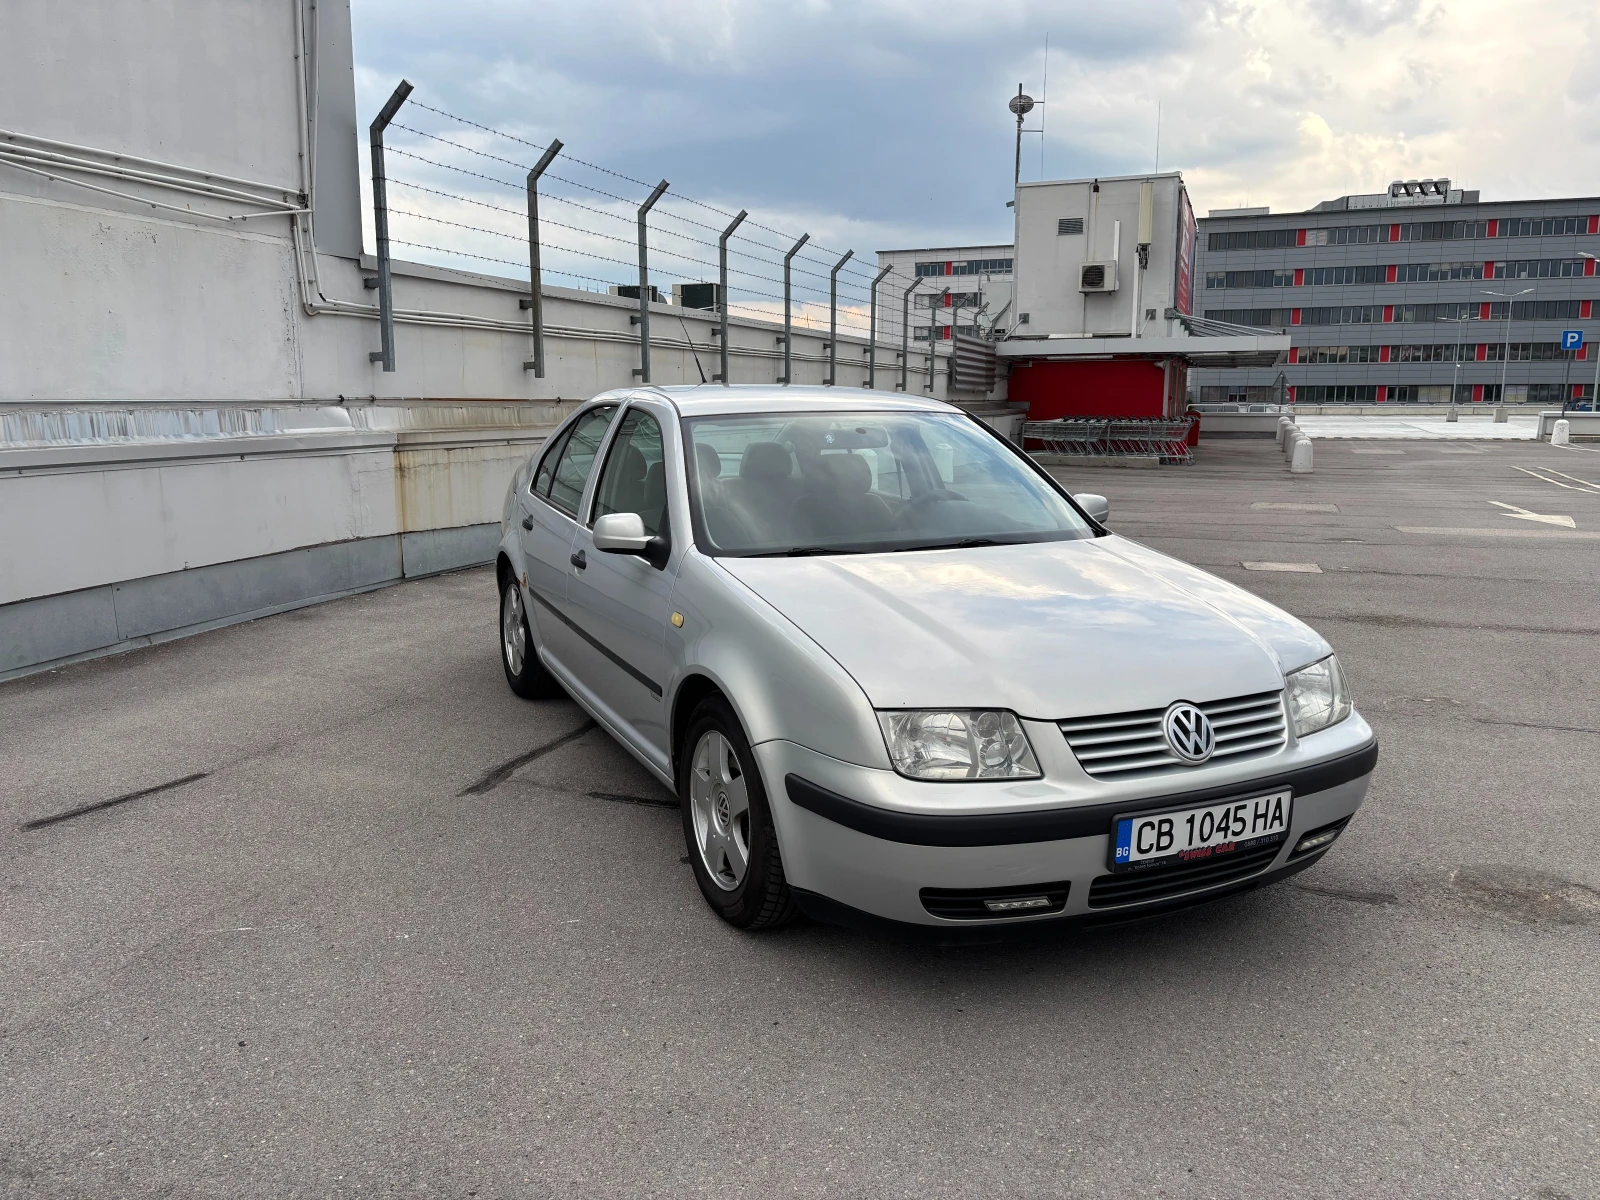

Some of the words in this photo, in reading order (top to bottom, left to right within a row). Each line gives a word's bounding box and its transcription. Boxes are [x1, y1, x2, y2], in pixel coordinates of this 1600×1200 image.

[1566, 333, 1579, 348] P
[1166, 705, 1212, 761] VW
[1136, 818, 1174, 854] CB
[1185, 804, 1248, 846] 1045
[1251, 797, 1283, 833] HA
[1116, 846, 1129, 857] BG
[1215, 841, 1236, 855] CAR
